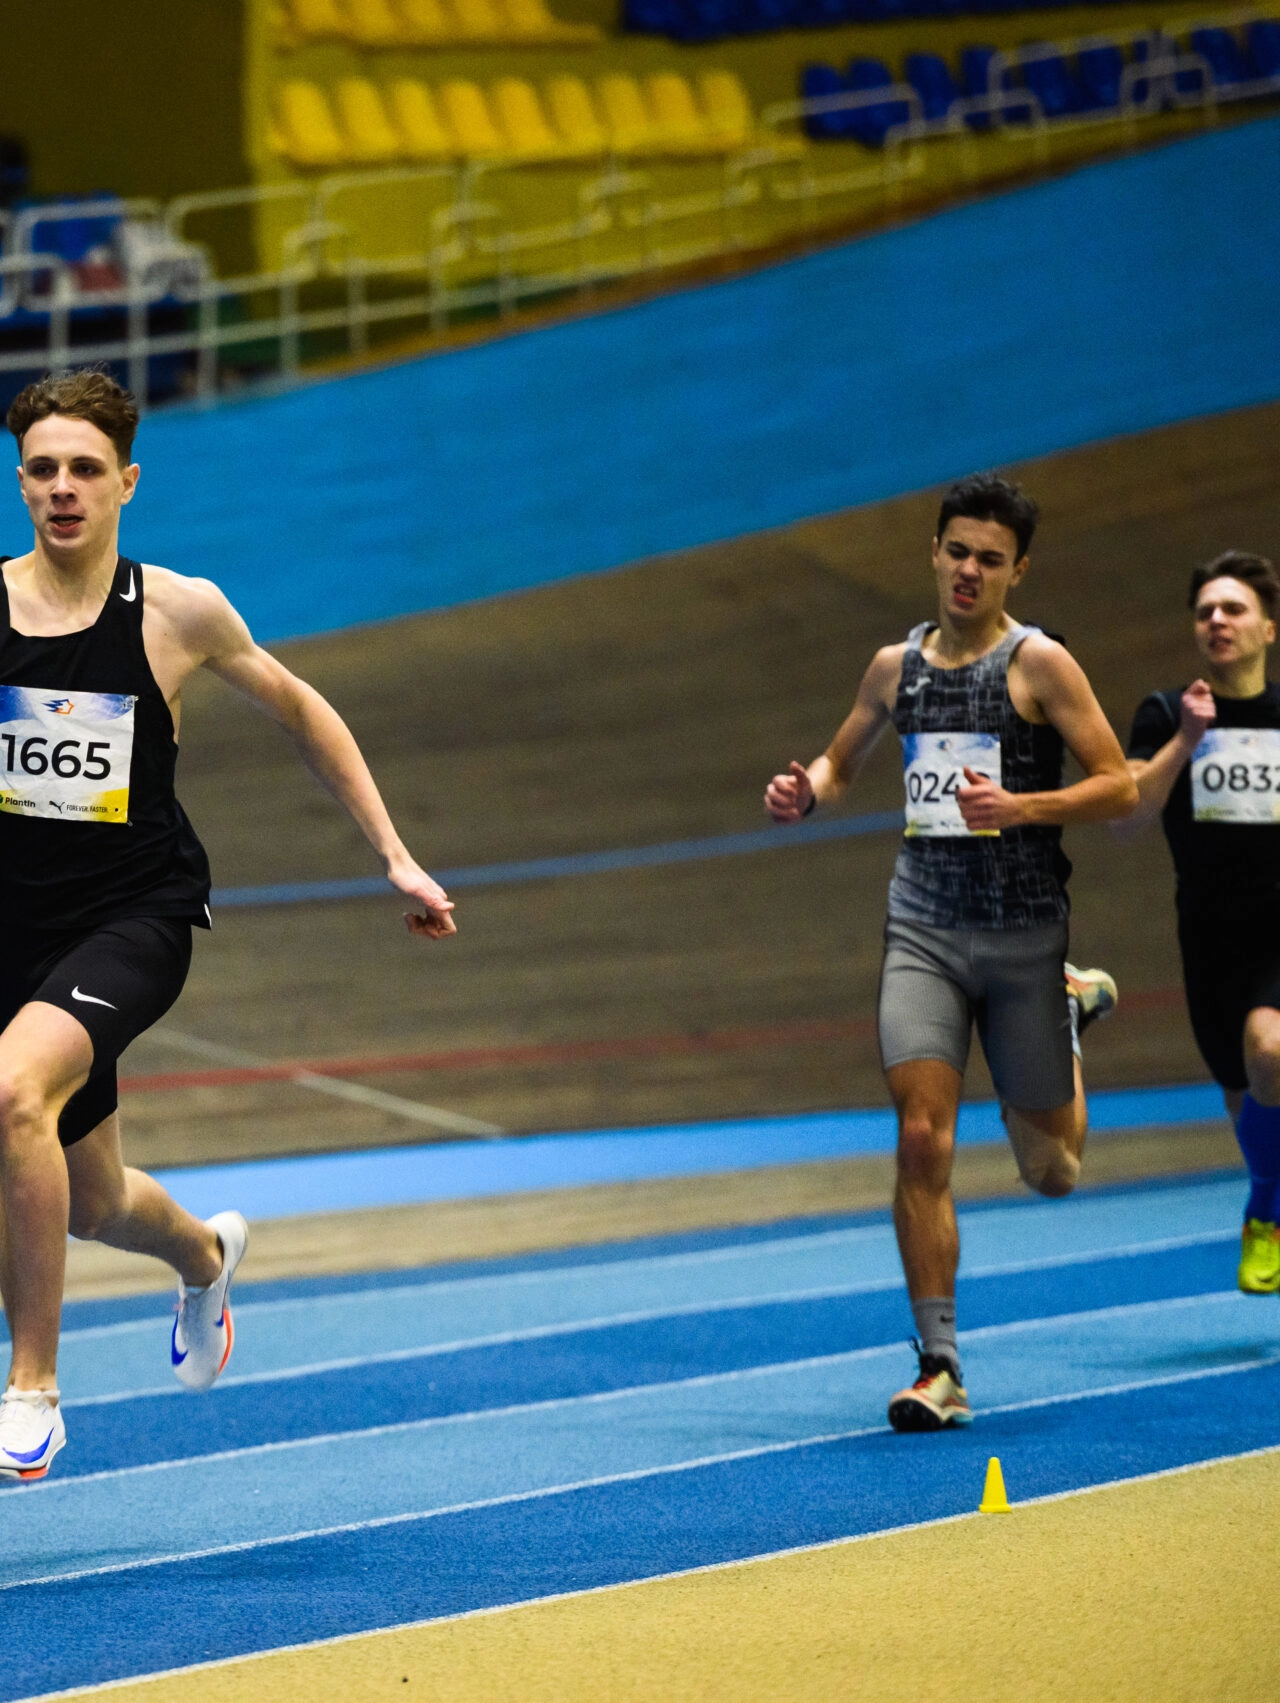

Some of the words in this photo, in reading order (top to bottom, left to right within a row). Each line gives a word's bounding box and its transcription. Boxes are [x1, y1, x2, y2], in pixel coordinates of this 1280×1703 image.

[1, 733, 112, 781] 1665
[5, 797, 36, 808] Plantin
[909, 772, 991, 804] 024
